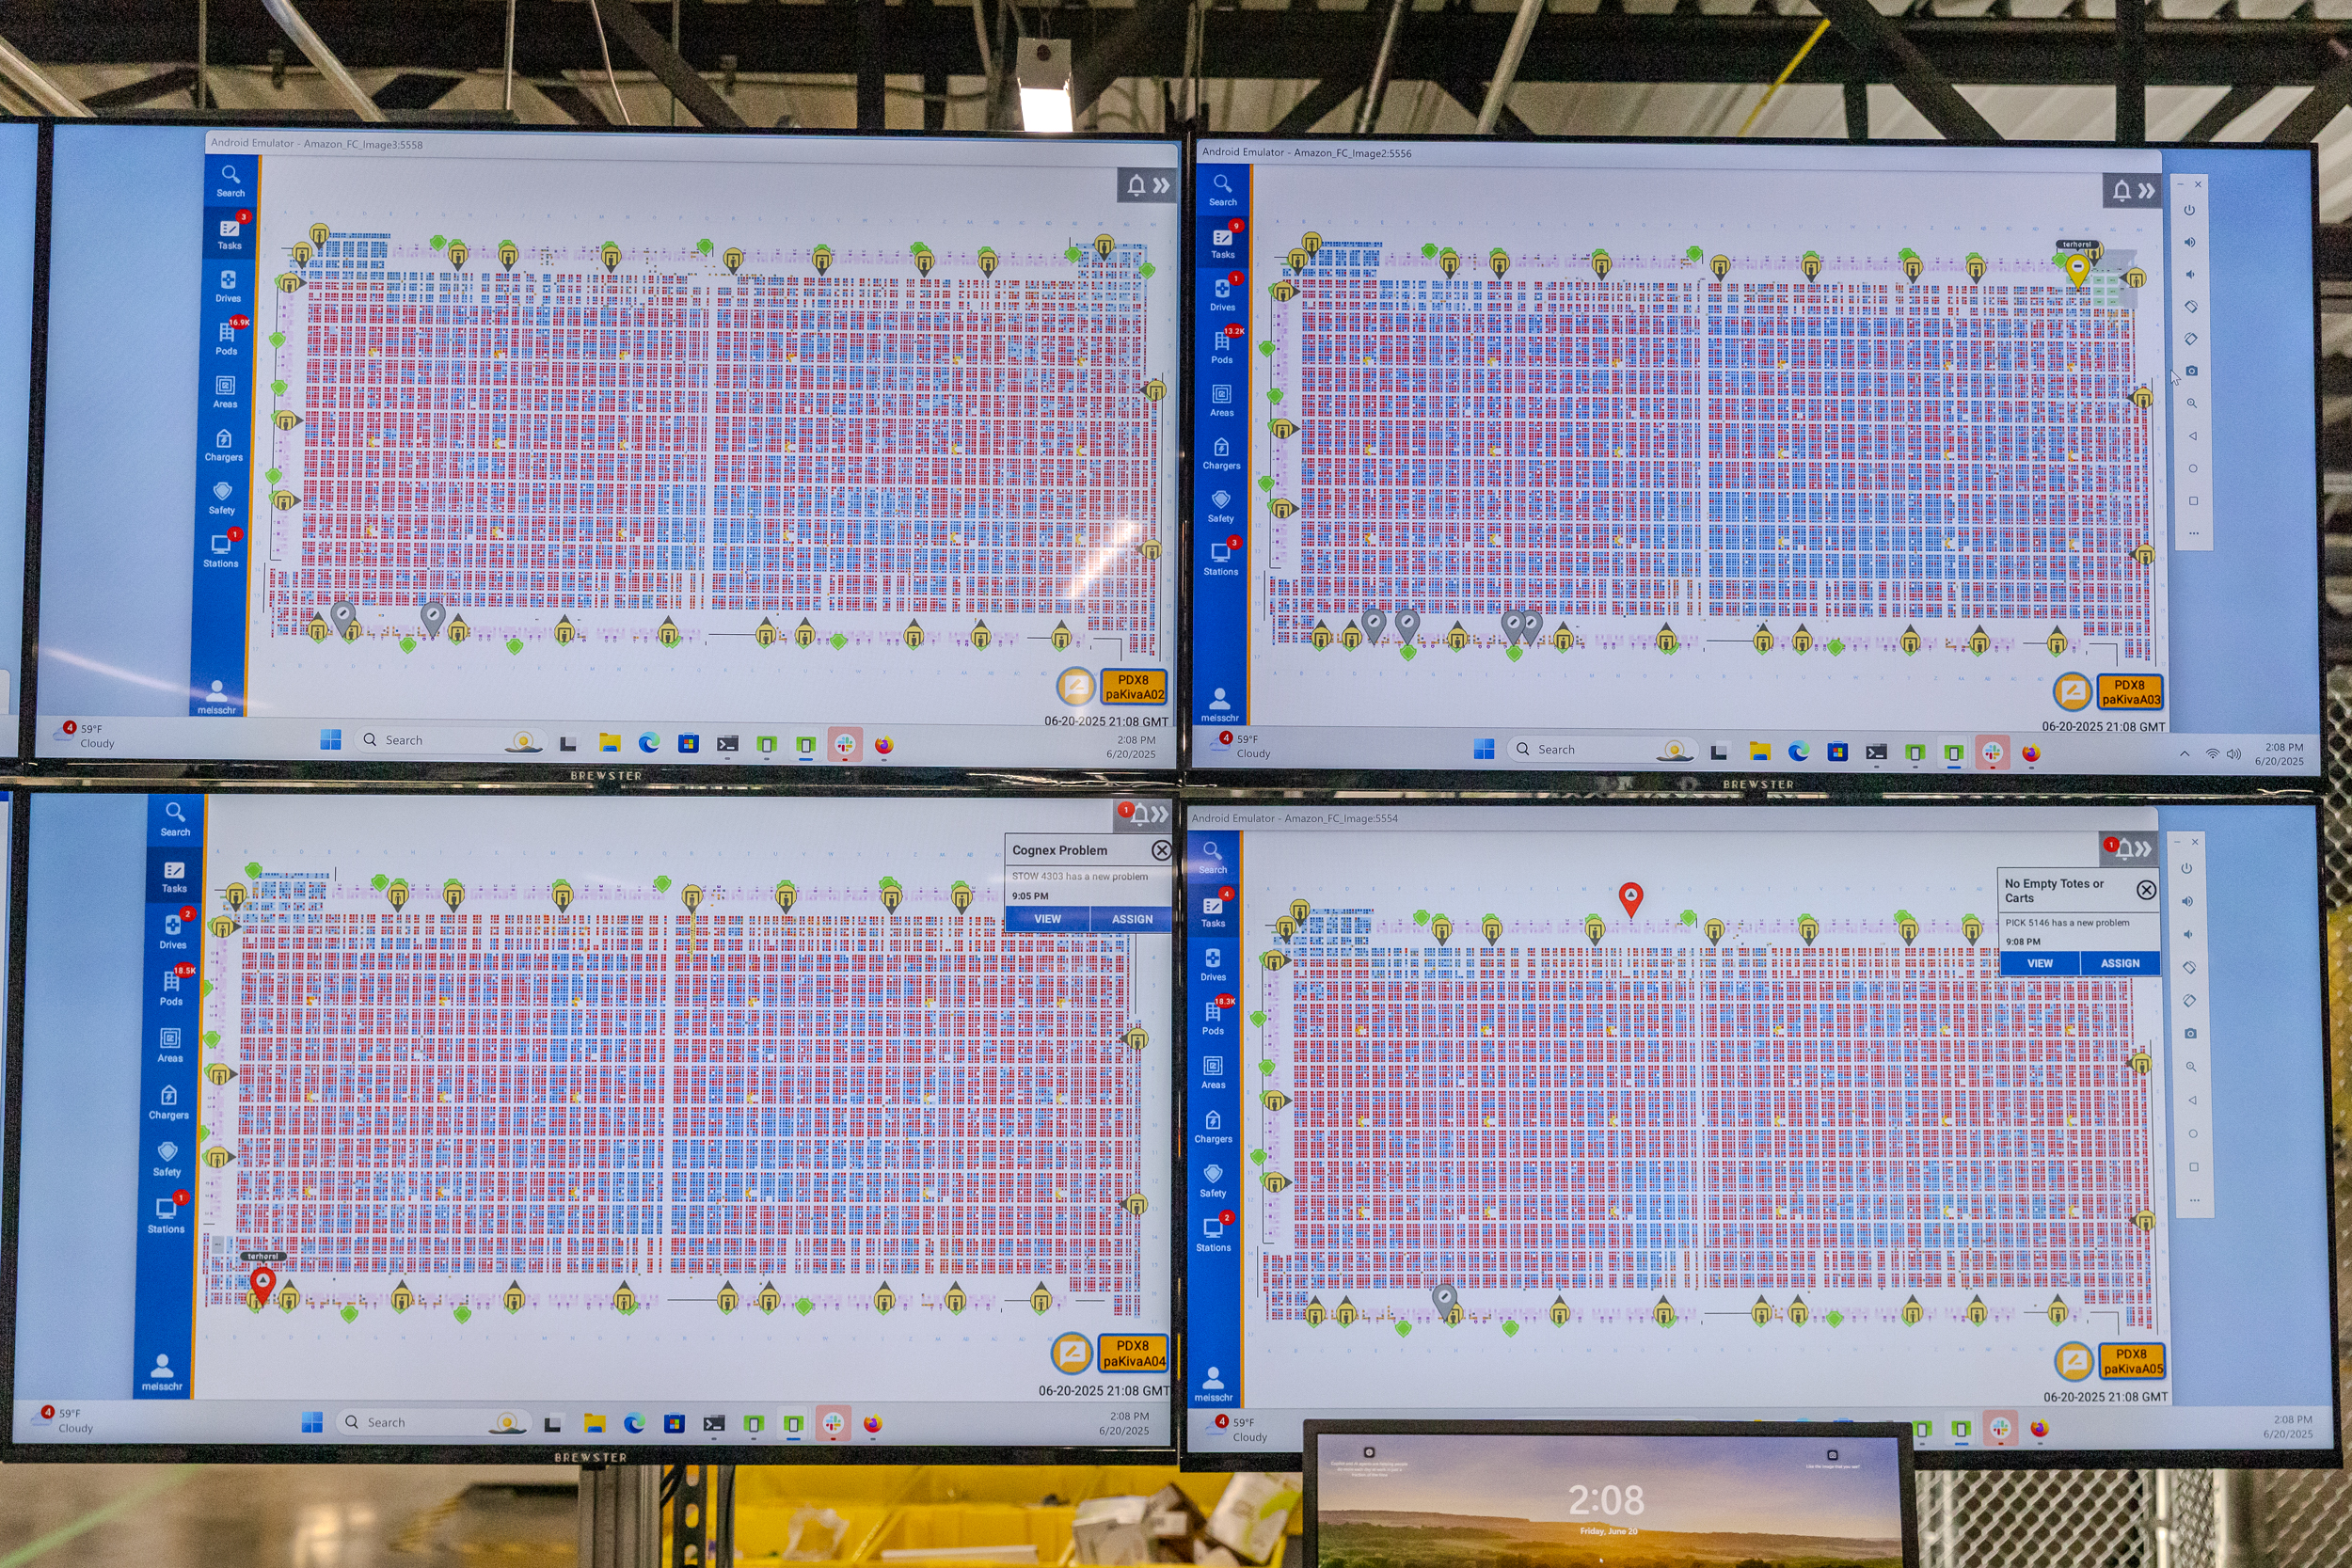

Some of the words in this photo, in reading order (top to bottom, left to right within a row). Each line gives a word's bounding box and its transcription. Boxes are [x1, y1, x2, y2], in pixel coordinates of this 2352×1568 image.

[211, 138, 248, 148] Android
[252, 138, 294, 149] Emulator
[304, 140, 423, 150] Amazon_FC_Image3:5558
[1202, 147, 1239, 156] Android
[1243, 147, 1284, 157] Emulator
[1295, 149, 1411, 159] Amazon_FC_Image2:5556
[216, 189, 245, 198] Search
[217, 242, 242, 250] Tasks
[215, 294, 241, 303] Drives
[1211, 303, 1235, 311] Drives
[215, 347, 237, 356] Pods
[1212, 356, 1232, 364] Pods
[214, 400, 238, 408] Areas
[205, 453, 243, 463] Chargers
[1203, 462, 1241, 471] Chargers
[209, 506, 235, 516] Safety
[1208, 515, 1234, 524] Safety
[203, 560, 239, 568] Stations
[1204, 567, 1239, 577] Stations
[1118, 675, 1149, 686] PDX8
[2115, 680, 2145, 690] PDX8
[1106, 688, 1165, 702] paKivaA02
[2103, 693, 2161, 707] paKivaA03
[1044, 717, 1106, 727] 06-20-2025
[1109, 717, 1140, 727] 21:08
[1143, 717, 1168, 727] GMT
[2042, 721, 2106, 732] 06-20-2025
[2108, 721, 2137, 732] 21:08
[2140, 721, 2166, 732] GMT
[81, 725, 103, 734] 59°F
[81, 738, 115, 750] Cloudy
[386, 735, 422, 746] Search
[1118, 736, 1138, 745] 2:08
[1140, 736, 1155, 745] PM
[1237, 736, 1258, 744] 59°F
[1539, 745, 1575, 754] Search
[2265, 742, 2287, 752] 2:08
[2288, 742, 2304, 752] PM
[1106, 749, 1155, 760] 6/20/2025
[1237, 750, 1271, 760] Cloudy
[2254, 755, 2304, 767] 6/20/2025
[570, 771, 642, 781] BREWSTER
[1724, 780, 1794, 789] BREWSTER
[1192, 815, 1230, 823] Android
[1232, 815, 1275, 823] Emulator
[1285, 815, 1398, 825] Amazon_FC_Image:5554
[161, 828, 190, 836] Search
[1013, 846, 1056, 857] Cognex
[1059, 846, 1107, 856] Problem
[1200, 865, 1227, 874] Search
[1012, 872, 1039, 880] STOW
[1041, 872, 1063, 880] 4303
[1066, 872, 1082, 880] has
[1113, 873, 1148, 882] problem
[162, 884, 187, 893] Tasks
[2006, 879, 2020, 889] No
[2024, 879, 2058, 891] Empty
[2060, 879, 2090, 889] Totes
[2006, 894, 2034, 903] Carts
[1035, 914, 1061, 924] VIEW
[1112, 914, 1153, 924] ASSIGN
[2096, 919, 2130, 927] problem
[160, 941, 186, 949] Drives
[2027, 959, 2053, 968] VIEW
[2101, 959, 2140, 968] ASSIGN
[160, 997, 183, 1006] Pods
[1202, 1081, 1226, 1089] Areas
[149, 1111, 189, 1121] Chargers
[1195, 1134, 1232, 1144] Chargers
[153, 1168, 181, 1178] Safety
[1200, 1189, 1227, 1199] Safety
[148, 1225, 185, 1233] Stations
[1196, 1243, 1232, 1252] Stations
[1117, 1340, 1149, 1352] PDX8
[2117, 1349, 2147, 1359] PDX8
[1104, 1354, 1167, 1370] paKivaA04
[2105, 1363, 2164, 1375] paKivaA05
[1039, 1386, 1104, 1397] 06-20-2025
[1107, 1386, 1140, 1397] 21:08
[1143, 1386, 1170, 1397] GMT
[2044, 1392, 2106, 1402] 06-20-2025
[2108, 1392, 2138, 1402] 21:08
[2141, 1392, 2168, 1402] GMT
[59, 1409, 81, 1418] 59°F
[1110, 1412, 1132, 1421] 2:08
[1134, 1412, 1150, 1421] PM
[368, 1417, 405, 1429] Search
[1233, 1418, 1254, 1427] 59°F
[2275, 1415, 2293, 1425] 2:08
[2296, 1415, 2312, 1425] PM
[58, 1423, 93, 1434] Cloudy
[1099, 1426, 1150, 1436] 6/20/2025
[1233, 1433, 1267, 1443] Cloudy
[2264, 1429, 2313, 1439] 6/20/2025
[555, 1453, 627, 1463] BREWSTER
[1569, 1484, 1644, 1516] 2:08
[1581, 1527, 1607, 1536] Friday,
[1608, 1527, 1626, 1535] June
[1629, 1527, 1638, 1535] 20
